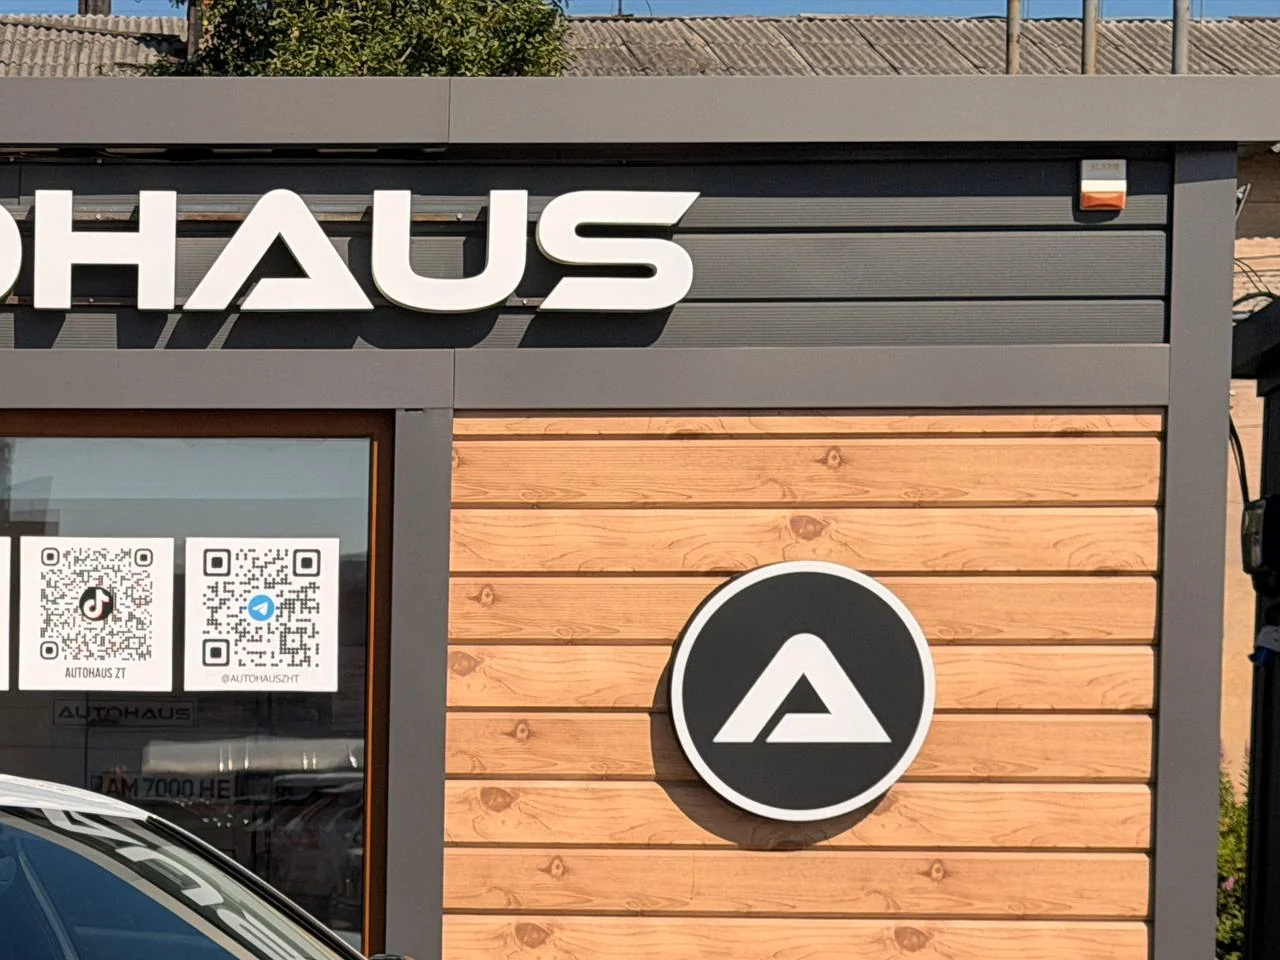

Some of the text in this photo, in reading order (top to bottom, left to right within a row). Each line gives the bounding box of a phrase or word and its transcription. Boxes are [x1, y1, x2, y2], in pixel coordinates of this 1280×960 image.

[65, 667, 126, 679] AUTOHAUS ZT
[221, 674, 301, 684] @AUTOHAUSZHT
[712, 632, 892, 743] A
[57, 706, 191, 721] AUTOHAUS
[142, 777, 195, 797] 7000
[200, 777, 231, 799] HE
